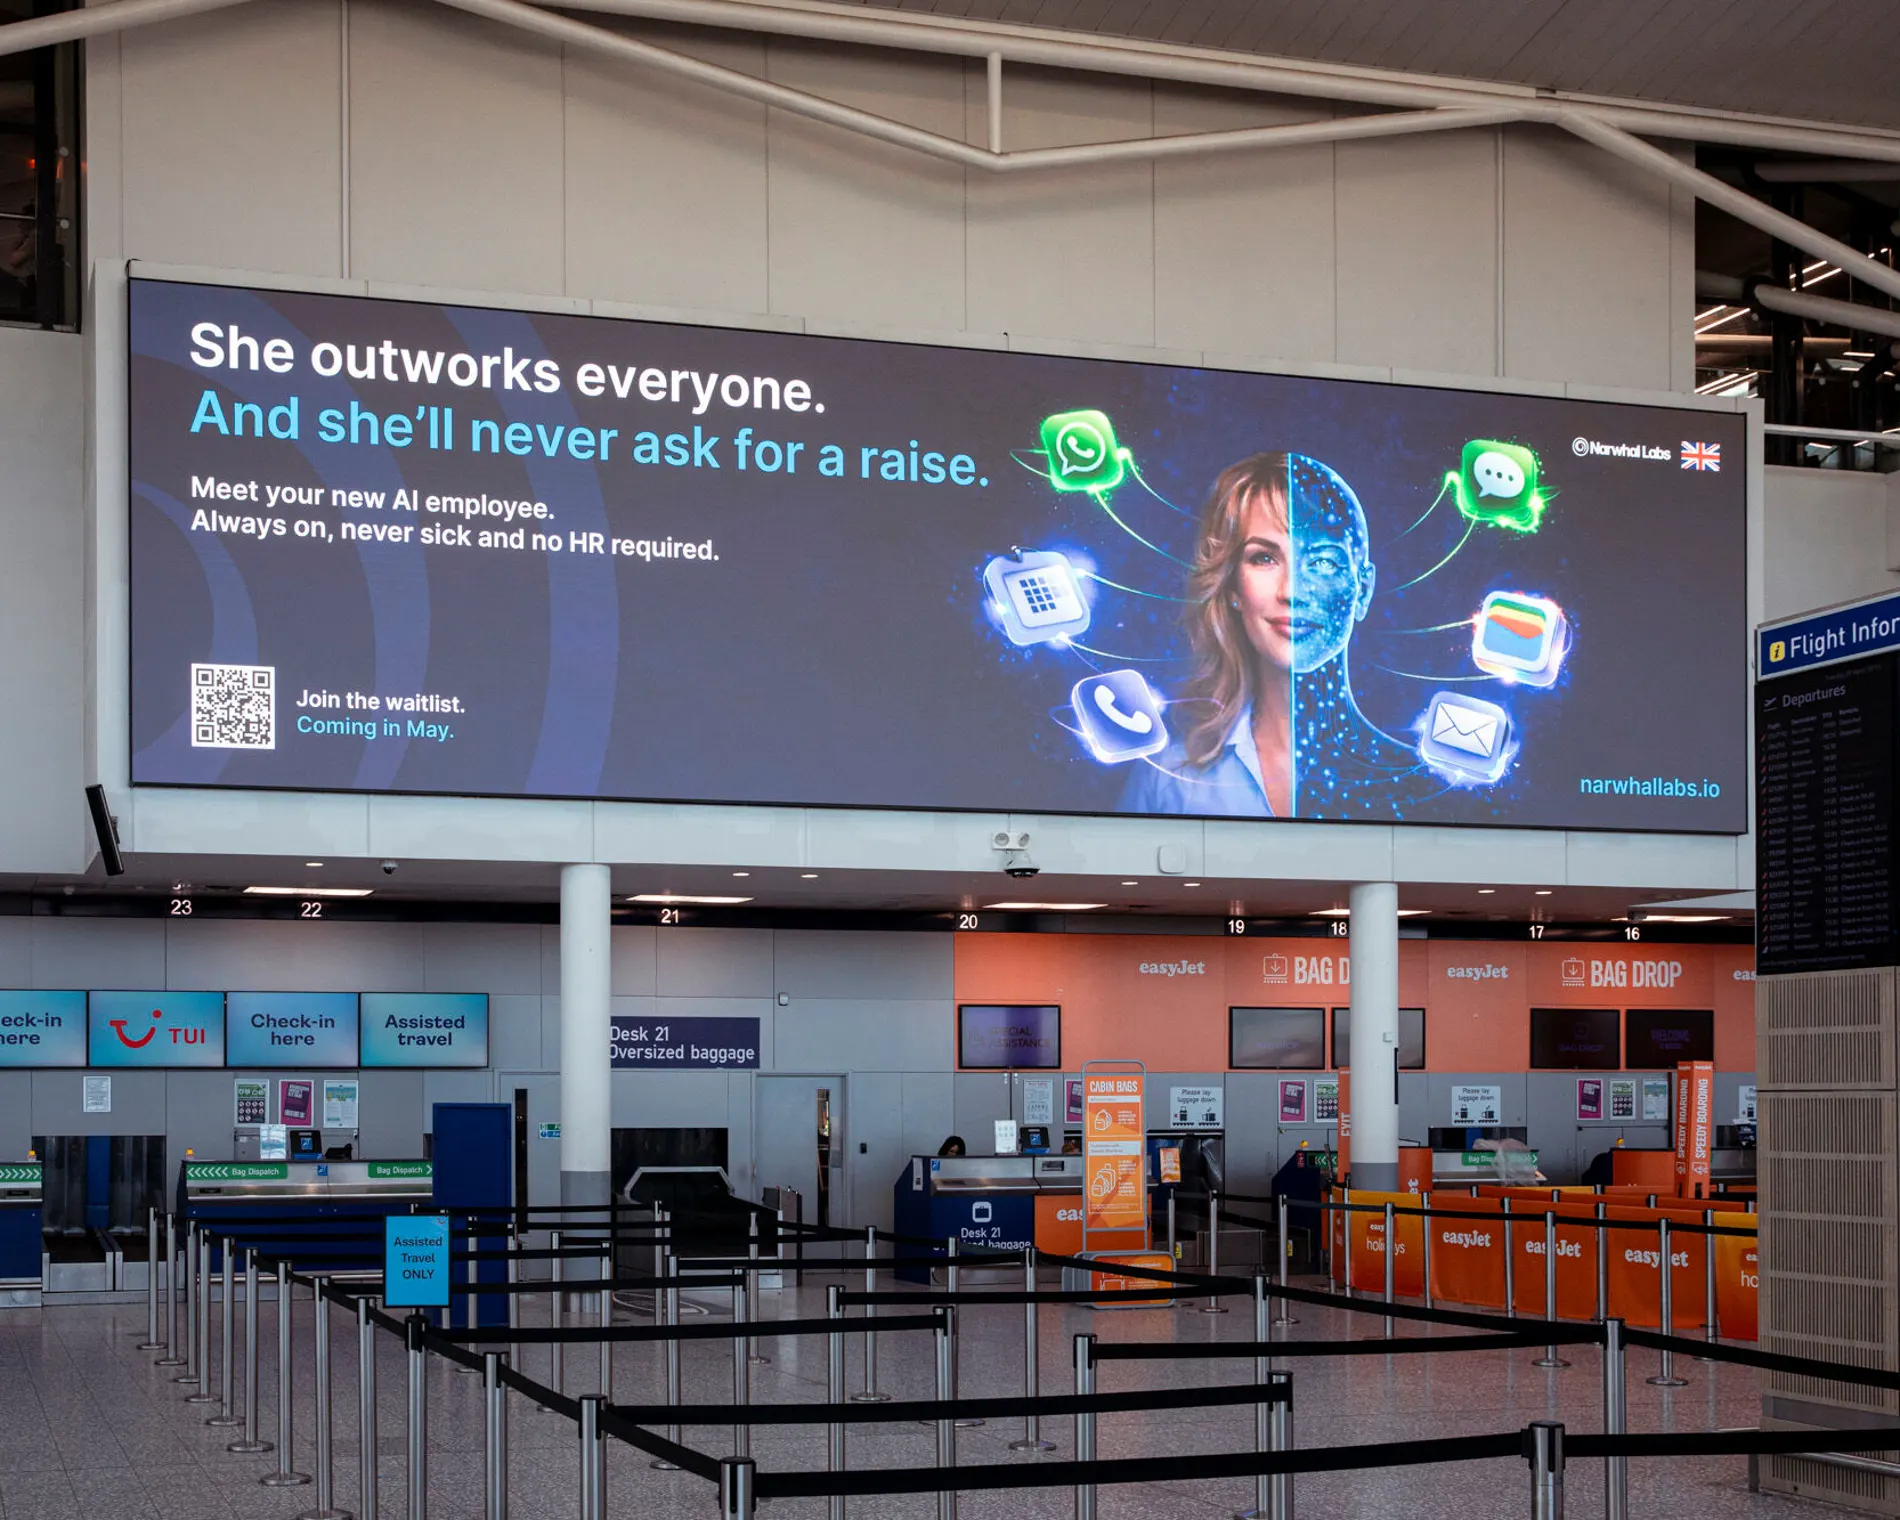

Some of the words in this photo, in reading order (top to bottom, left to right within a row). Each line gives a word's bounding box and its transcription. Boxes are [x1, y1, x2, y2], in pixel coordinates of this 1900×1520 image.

[190, 322, 295, 374] She
[311, 339, 561, 393] outworks
[576, 360, 826, 414] everyone.
[190, 390, 299, 440] And
[317, 400, 453, 450] she’ll
[471, 418, 618, 461] never
[633, 425, 721, 469] ask
[734, 427, 804, 474] for
[817, 444, 845, 477] a
[860, 440, 989, 487] raise.
[1589, 440, 1641, 458] Narwhal
[1642, 445, 1671, 460] Labs
[191, 476, 258, 502] Meet
[265, 484, 325, 508] your
[331, 488, 386, 509] new
[392, 488, 418, 511] AI
[425, 494, 555, 522] employee.
[190, 509, 287, 539] Always
[293, 518, 334, 543] on,
[341, 521, 414, 543] never
[420, 523, 471, 546] sick
[478, 527, 524, 551] and
[531, 533, 562, 552] no
[569, 531, 605, 555] HR
[611, 537, 720, 562] required.
[1790, 626, 1846, 658] Flight
[1852, 616, 1900, 644] Infor
[296, 689, 340, 709] Join
[345, 691, 381, 710] the
[385, 693, 466, 713] waitlist.
[1782, 684, 1846, 708] Departures
[297, 715, 376, 740] Coming
[383, 717, 401, 736] in
[407, 719, 455, 742] May.
[1580, 776, 1720, 798] narwhallabs.io
[170, 900, 192, 916] 23
[301, 902, 322, 918] 22
[661, 908, 680, 924] 21
[959, 914, 978, 930] 20
[1228, 919, 1245, 935] 19
[1331, 921, 1348, 936] 18
[1529, 925, 1545, 939] 17
[1625, 927, 1640, 941] 16
[1139, 959, 1205, 977] easyJet
[1294, 956, 1333, 985] BAG
[1447, 963, 1509, 981] easyJet
[1590, 960, 1627, 988] BAG
[1632, 960, 1682, 988] DROP
[0, 1012, 62, 1027] eck-in
[250, 1013, 336, 1029] Check-in
[384, 1014, 465, 1029] Assisted
[168, 1028, 205, 1044] TUI
[270, 1031, 316, 1046] here
[397, 1031, 452, 1046] travel
[610, 1026, 649, 1041] Desk
[655, 1026, 669, 1041] 21
[609, 1044, 684, 1059] Oversized
[691, 1044, 755, 1063] baggage
[1089, 1081, 1115, 1092] CABIN
[1116, 1080, 1138, 1092] BAGS
[1679, 1079, 1689, 1123] BOARDING
[1696, 1079, 1709, 1123] BOARDING
[1678, 1124, 1687, 1159] SPEEDY
[1695, 1123, 1708, 1159] SPEEDY
[232, 1168, 246, 1177] Bag
[248, 1167, 279, 1177] Dispatch
[376, 1166, 390, 1175] Bag
[392, 1165, 423, 1175] Dispatch
[961, 1227, 987, 1238] Desk
[991, 1227, 1001, 1238] 21
[1370, 1223, 1386, 1232] easy
[394, 1236, 443, 1247] Assisted
[1442, 1229, 1492, 1248] easyJet
[1525, 1239, 1582, 1258] easJet
[401, 1253, 436, 1264] Travel
[1624, 1248, 1689, 1268] easyet
[402, 1269, 435, 1280] ONLY
